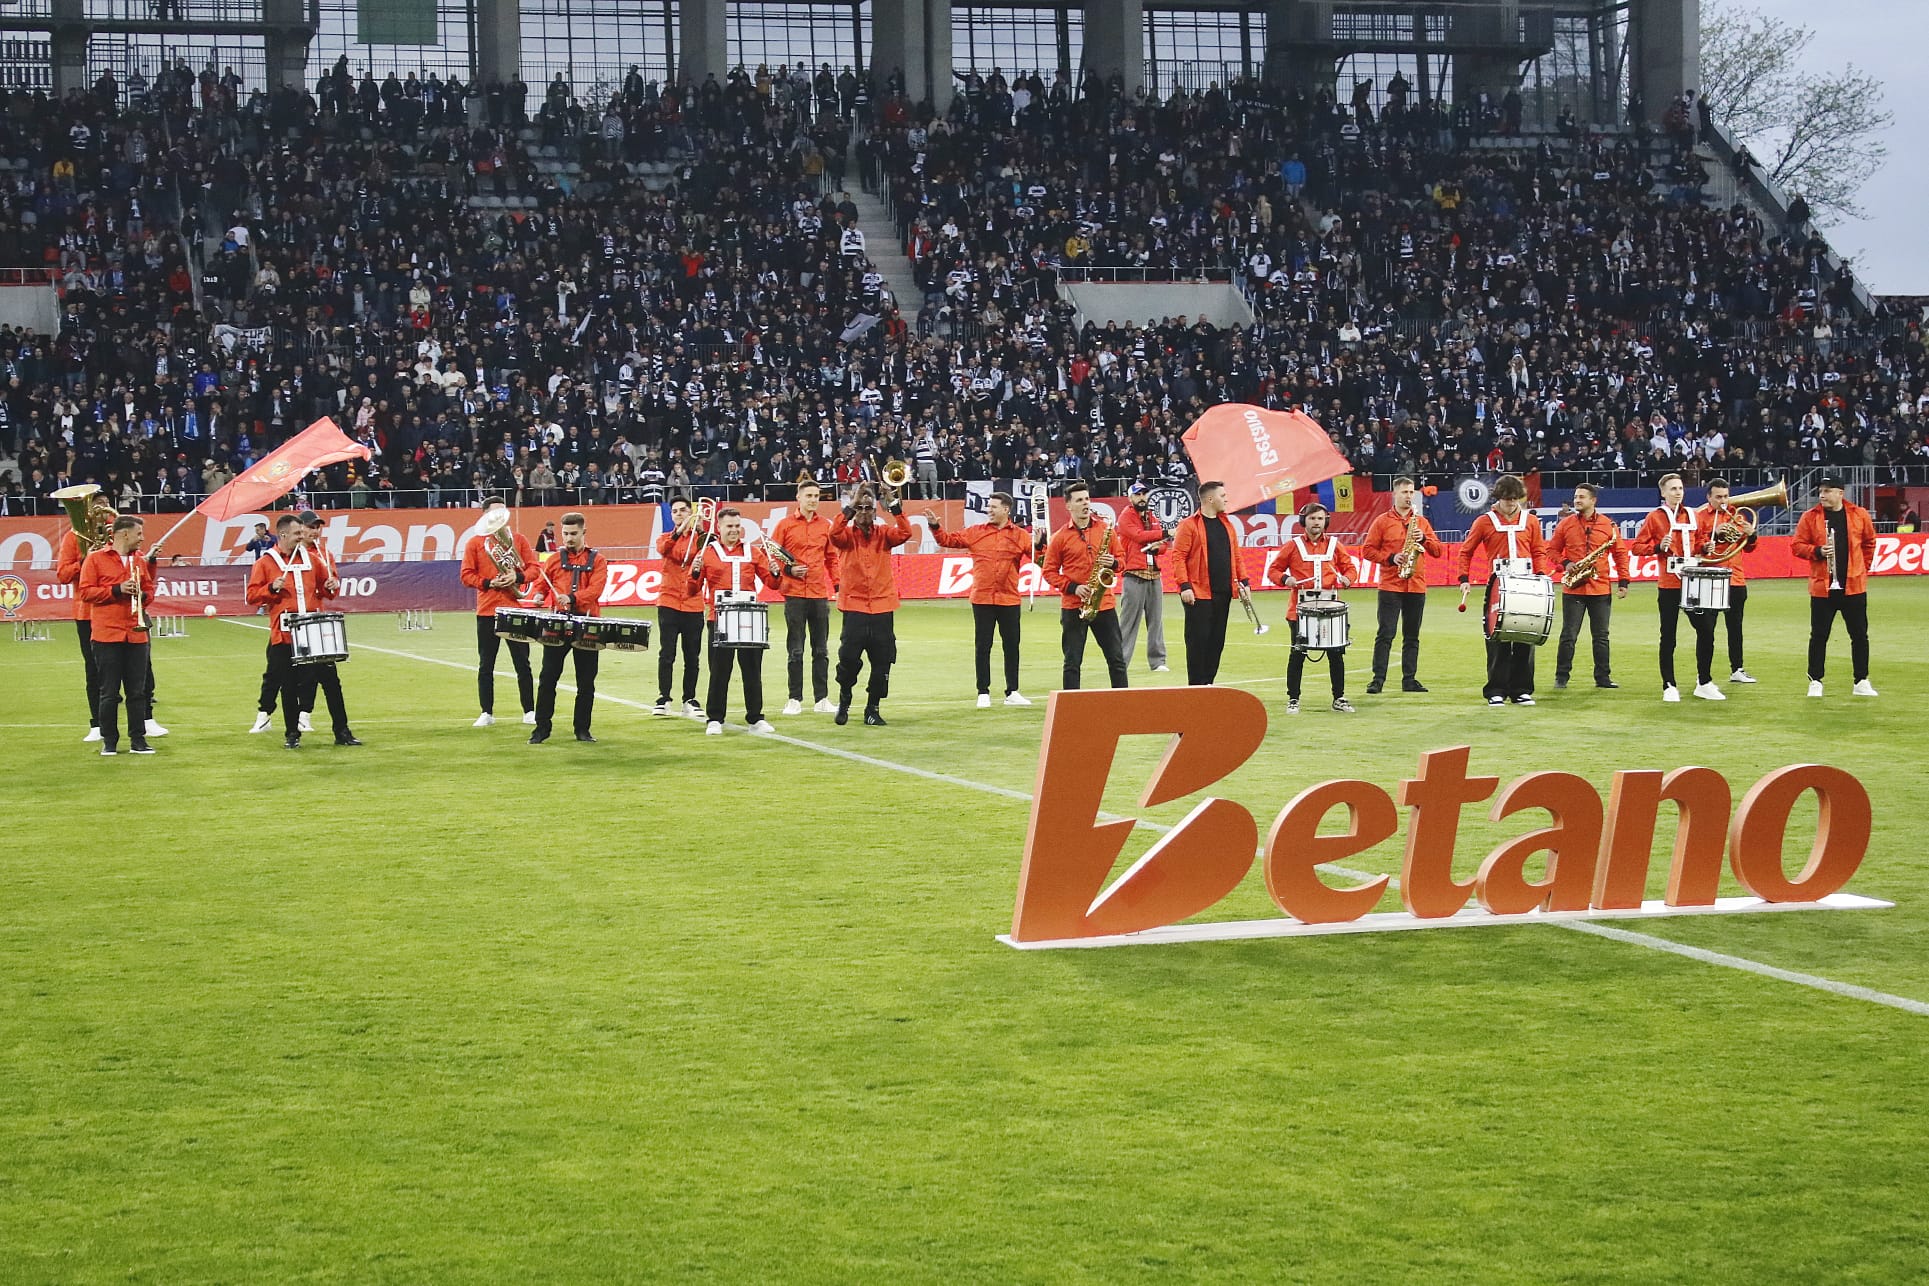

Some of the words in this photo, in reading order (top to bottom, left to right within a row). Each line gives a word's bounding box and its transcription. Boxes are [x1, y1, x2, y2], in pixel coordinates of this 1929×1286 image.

[1160, 499, 1178, 522] U
[201, 514, 475, 562] Btan
[1868, 537, 1929, 572] Bet
[36, 584, 73, 599] CU
[154, 577, 218, 597] ÂNIEI
[1010, 686, 1872, 942] Betano
